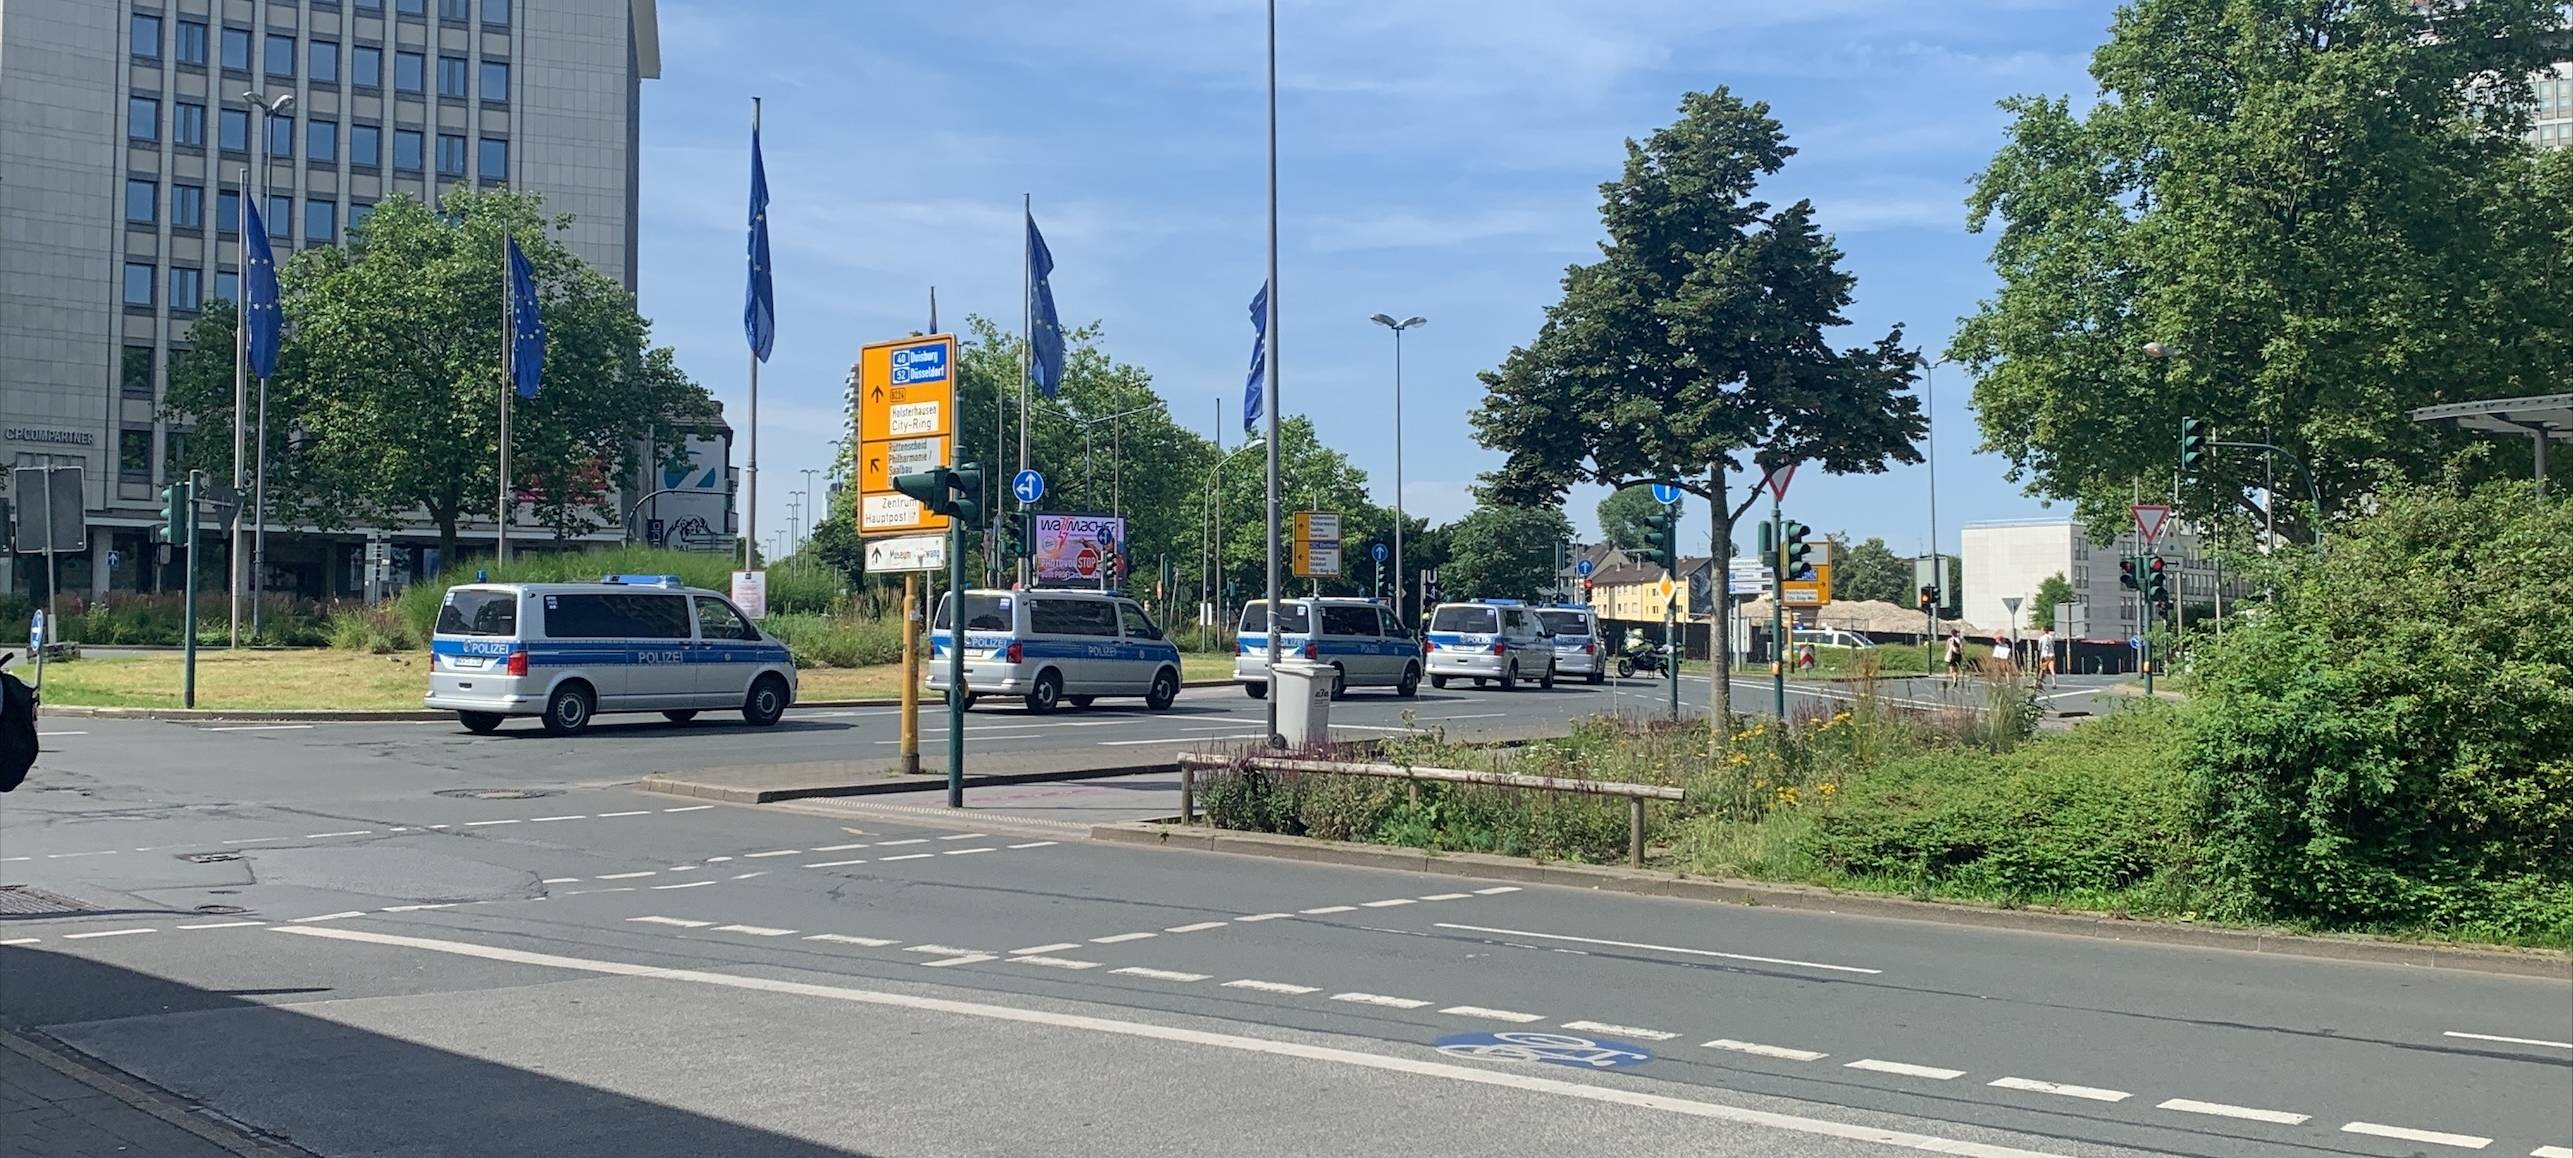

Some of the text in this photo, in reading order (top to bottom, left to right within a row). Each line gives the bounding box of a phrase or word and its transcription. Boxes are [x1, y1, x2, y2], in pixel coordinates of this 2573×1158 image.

[910, 350, 938, 364] Duisburg
[896, 364, 945, 381] 52 Düsseldorf
[892, 405, 937, 418] Holsterhausen
[892, 418, 932, 432] City-Ring
[888, 464, 913, 475] Saalbau
[882, 497, 917, 509] Zentrum
[865, 512, 907, 526] Hauptpost
[1077, 557, 1097, 569] STOP
[1426, 568, 1438, 584] U
[471, 643, 509, 654] POLIZEI
[972, 638, 1008, 648] POLIZEI
[638, 651, 684, 664] POLIZEI
[1088, 645, 1118, 657] POLIZEI
